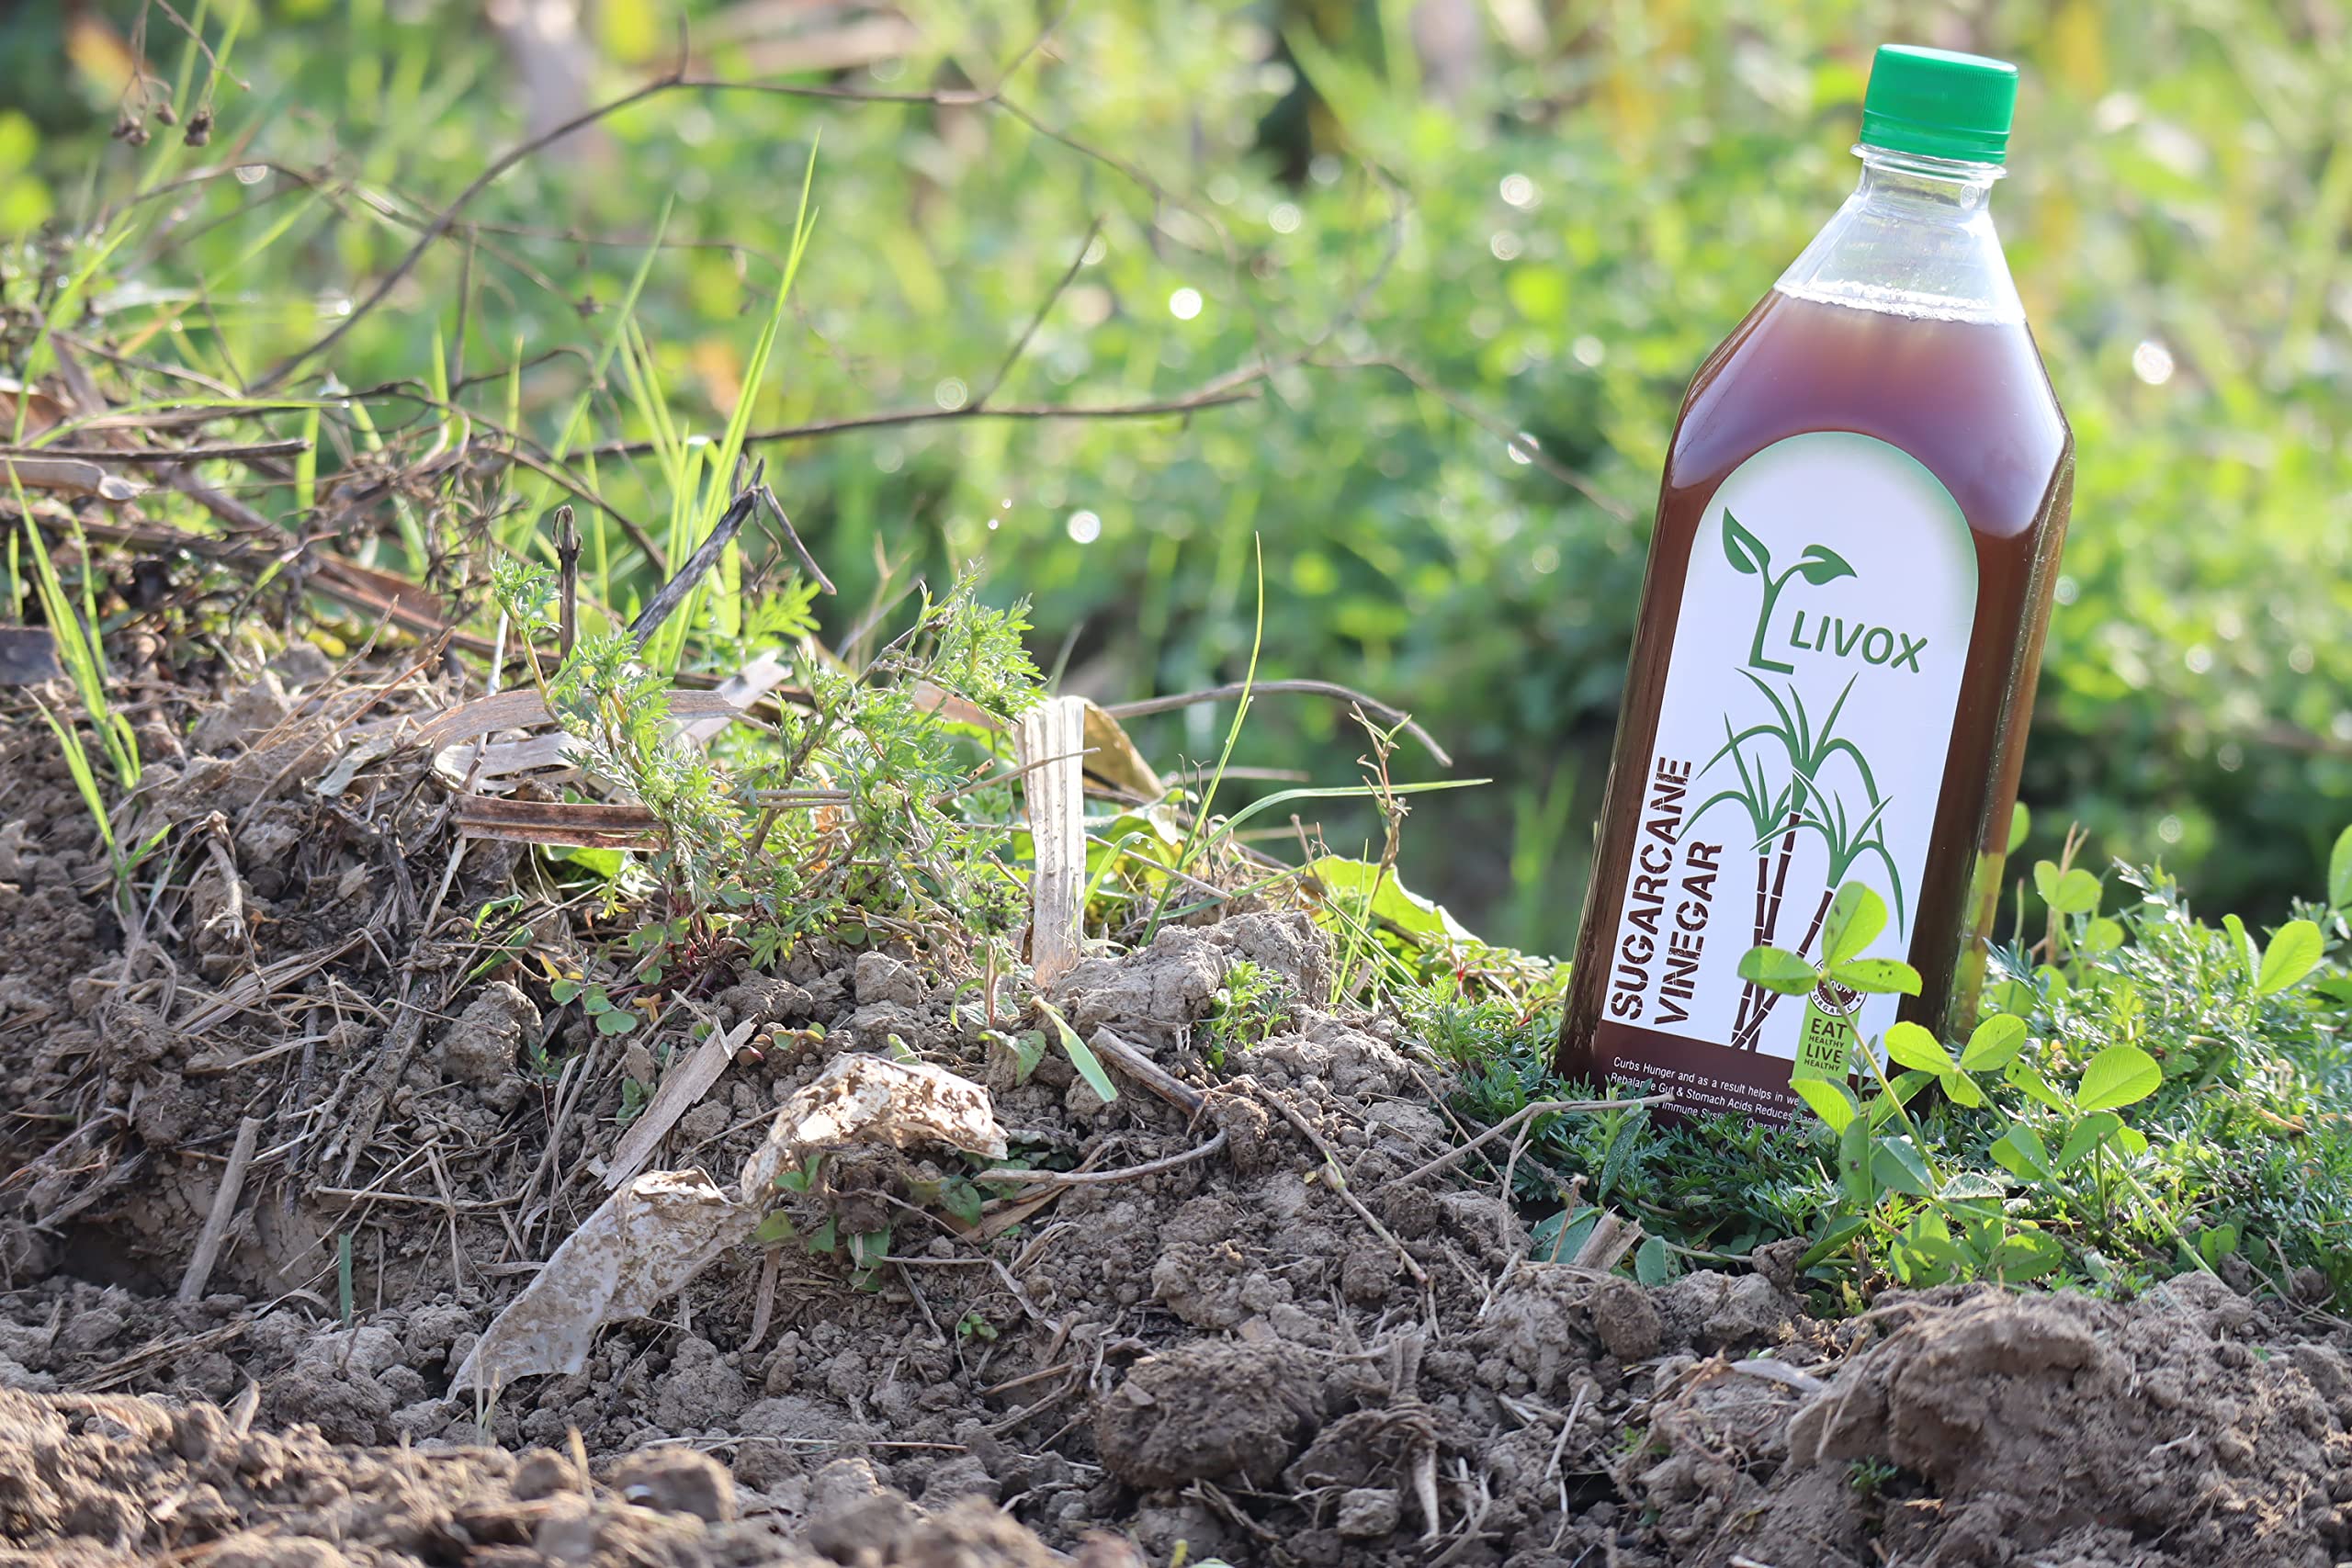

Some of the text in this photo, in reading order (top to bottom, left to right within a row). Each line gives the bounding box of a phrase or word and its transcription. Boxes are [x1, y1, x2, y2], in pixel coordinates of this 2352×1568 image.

[1790, 610, 1928, 673] LIVOX
[1611, 756, 1691, 1021] SUGARCANE
[1654, 840, 1724, 1025] VINEGAR
[1823, 979, 1852, 995] 00%
[1813, 994, 1853, 1015] ORGANC
[1811, 1018, 1848, 1040] EAT
[1808, 1035, 1845, 1048] HEALTHY
[1806, 1043, 1843, 1064] LIVE
[1804, 1059, 1840, 1072] HEALTHY
[1613, 1056, 1640, 1071] Curbs
[1643, 1063, 1676, 1078] Hunger
[1678, 1072, 1695, 1083] and
[1698, 1076, 1708, 1086] as
[1712, 1079, 1717, 1088] a
[1720, 1081, 1746, 1094] result
[1747, 1086, 1771, 1100] helps
[1775, 1091, 1783, 1102] in
[1658, 1082, 1675, 1095] Gut
[1676, 1087, 1683, 1097] &
[1686, 1089, 1725, 1106] Stomach
[1727, 1098, 1752, 1112] Acids
[1755, 1103, 1793, 1122] Reduces
[1662, 1101, 1699, 1116] Immune
